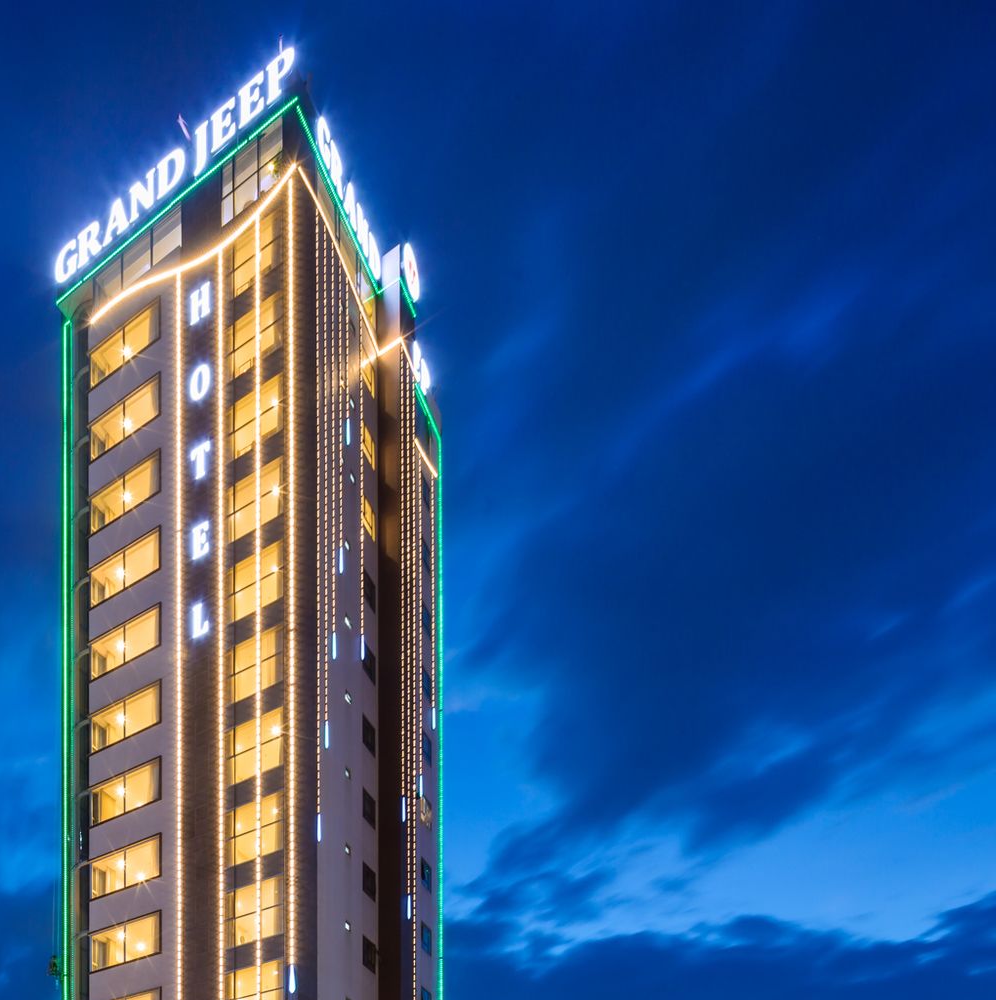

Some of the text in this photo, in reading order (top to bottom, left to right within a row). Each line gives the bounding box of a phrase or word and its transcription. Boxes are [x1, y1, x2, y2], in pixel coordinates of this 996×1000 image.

[54, 46, 296, 284] GRAND JEEP
[317, 115, 382, 282] GRAND
[189, 280, 212, 640] HOTEL
